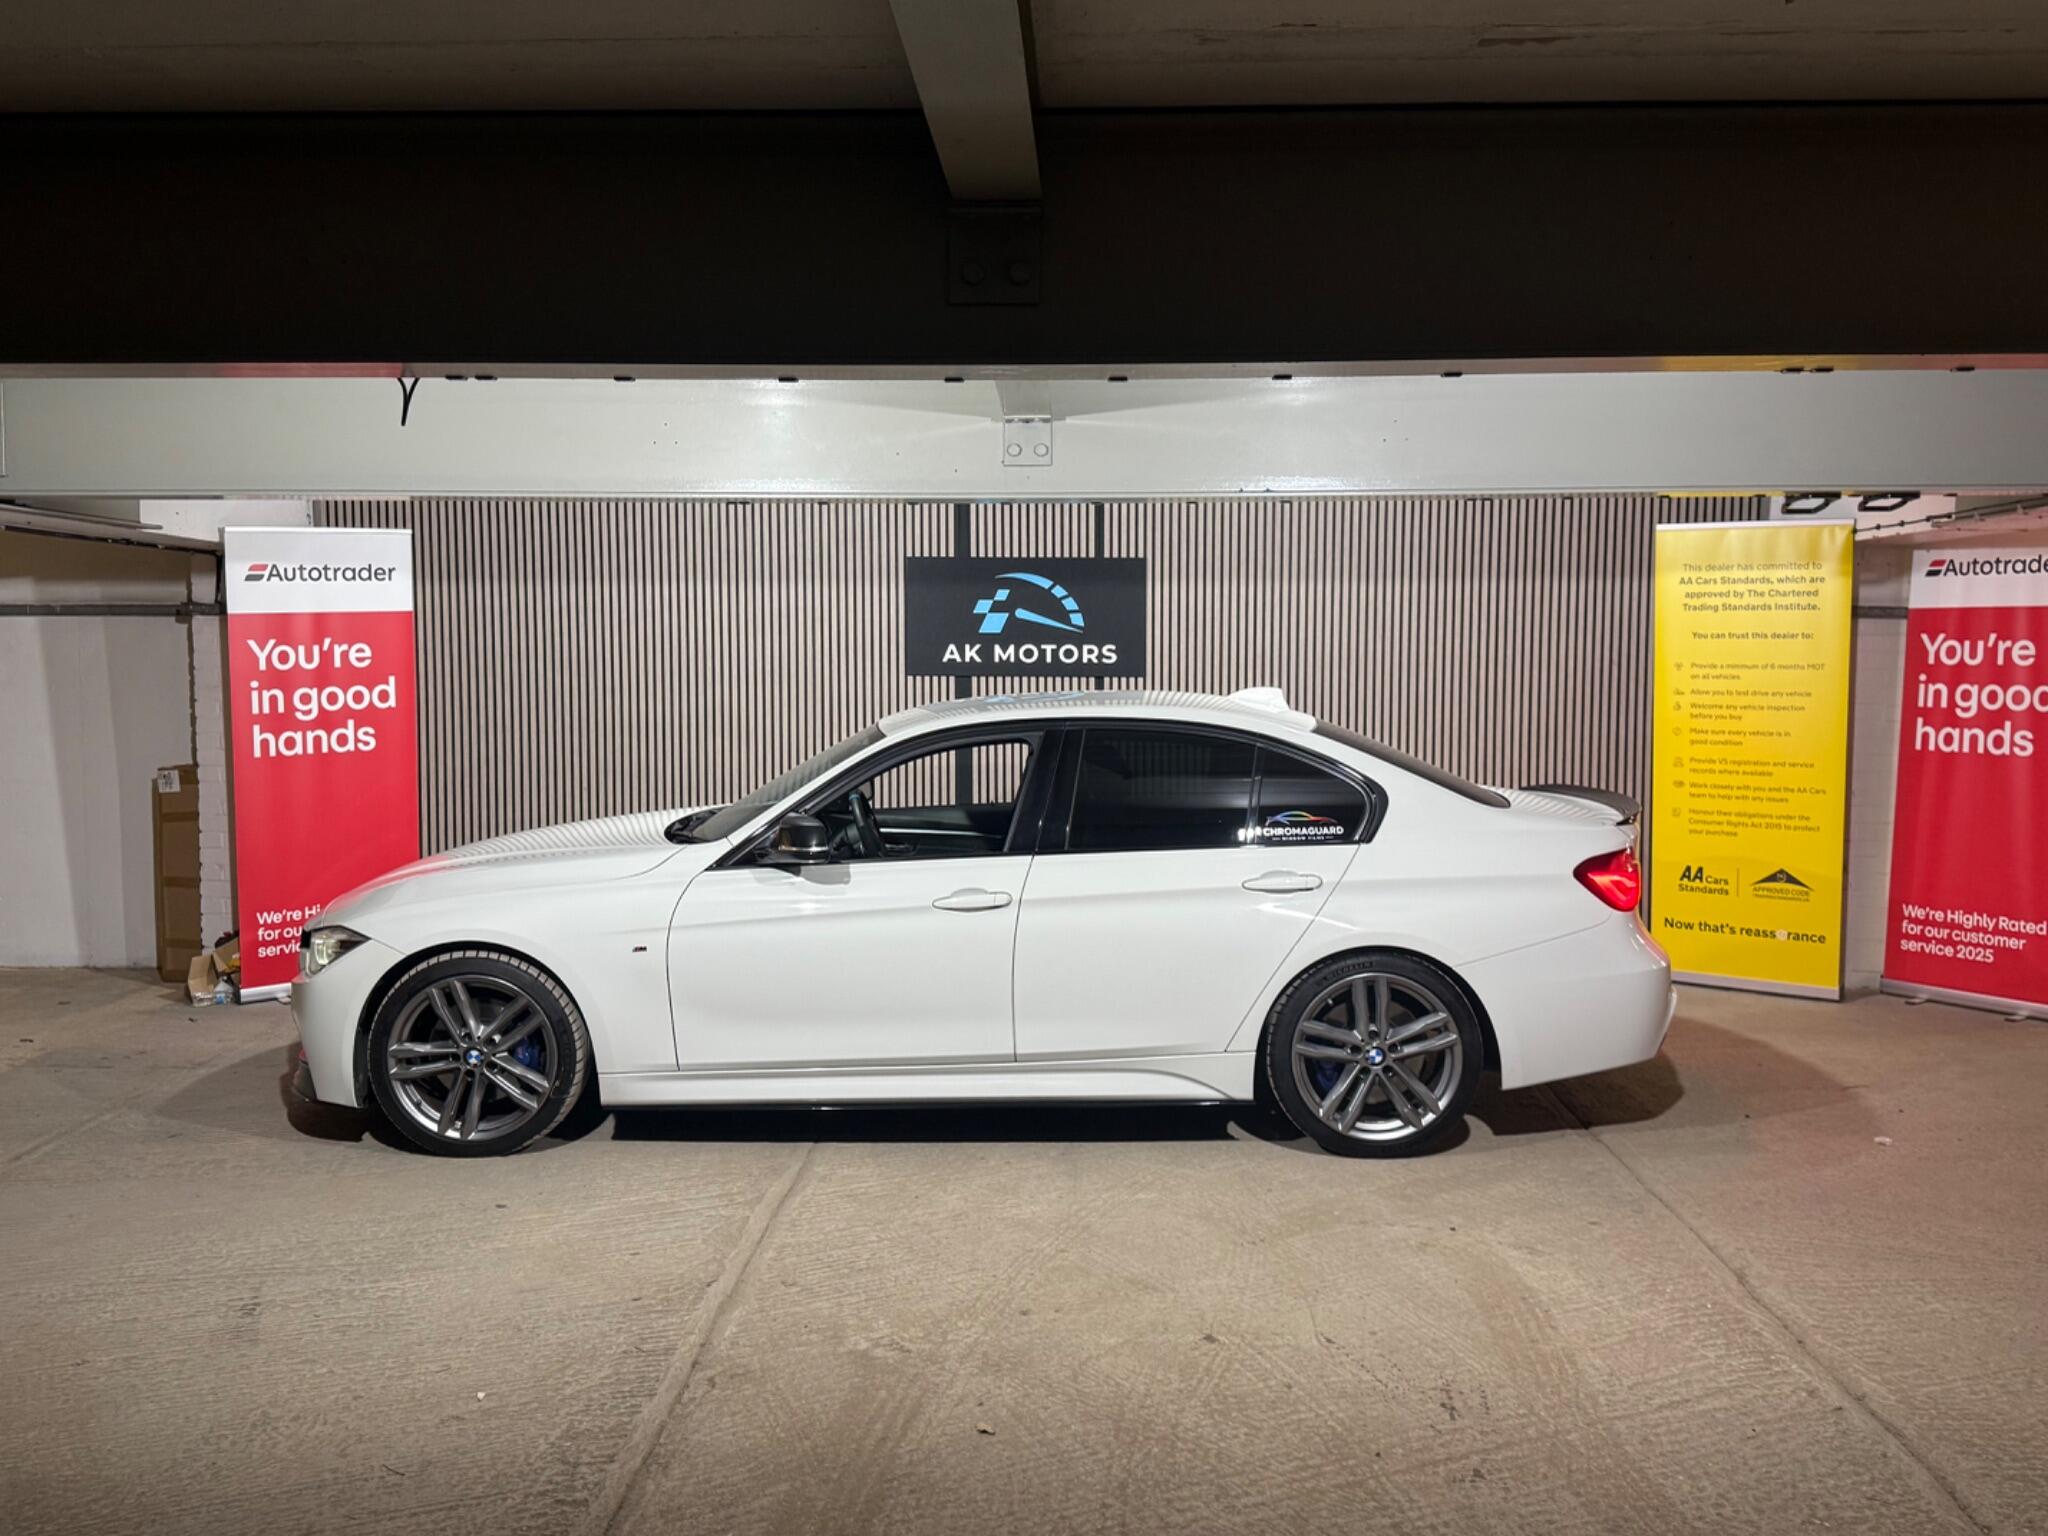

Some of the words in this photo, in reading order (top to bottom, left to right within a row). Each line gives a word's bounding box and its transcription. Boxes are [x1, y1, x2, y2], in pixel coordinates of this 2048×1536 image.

[266, 563, 396, 582] Autotrader
[1683, 562, 1702, 571] This
[1704, 562, 1734, 571] dealer
[1736, 562, 1754, 571] has
[1756, 561, 1810, 571] committed
[1812, 561, 1823, 570] to
[1679, 576, 1693, 585] AA
[1695, 576, 1718, 585] Cars
[1720, 576, 1774, 586] Standards,
[1776, 575, 1807, 584] which
[1808, 576, 1826, 584] are
[1685, 590, 1730, 600] approved
[1733, 589, 1744, 599] by
[1747, 589, 1765, 598] The
[1768, 588, 1819, 598] Chartered
[1682, 602, 1719, 613] Trading
[1721, 602, 1772, 611] Standards
[1774, 602, 1821, 611] Institute.
[1692, 631, 1709, 640] You
[1710, 632, 1726, 640] can
[1728, 632, 1749, 640] trust
[1751, 631, 1768, 640] this
[1770, 631, 1799, 640] dealer
[1801, 631, 1815, 640] to:
[246, 637, 373, 671] You're
[942, 643, 982, 663] AK
[993, 643, 1118, 664] MOTORS
[1921, 632, 2036, 667] You're
[250, 680, 285, 715] in
[293, 675, 396, 721] good
[1917, 673, 1949, 708] in
[253, 719, 376, 758] hands
[1915, 716, 2034, 757] hands
[1262, 826, 1344, 837] CHROMAGUARD
[1679, 865, 1704, 883] AA
[1705, 875, 1729, 885] Cars
[1678, 883, 1729, 896] Standards
[256, 909, 302, 925] We're
[1902, 903, 1945, 922] We're
[1947, 909, 1997, 931] Highly
[1998, 916, 2047, 936] Rated
[257, 927, 281, 942] for
[283, 925, 303, 939] ou
[1664, 916, 1694, 931] Now
[1698, 920, 1736, 935] that's
[1739, 926, 1826, 944] reassrance
[1902, 919, 1926, 936] for
[1924, 926, 1950, 940] our
[1951, 928, 2026, 950] customer
[1900, 938, 1954, 957] service
[1956, 945, 1995, 963] 2025
